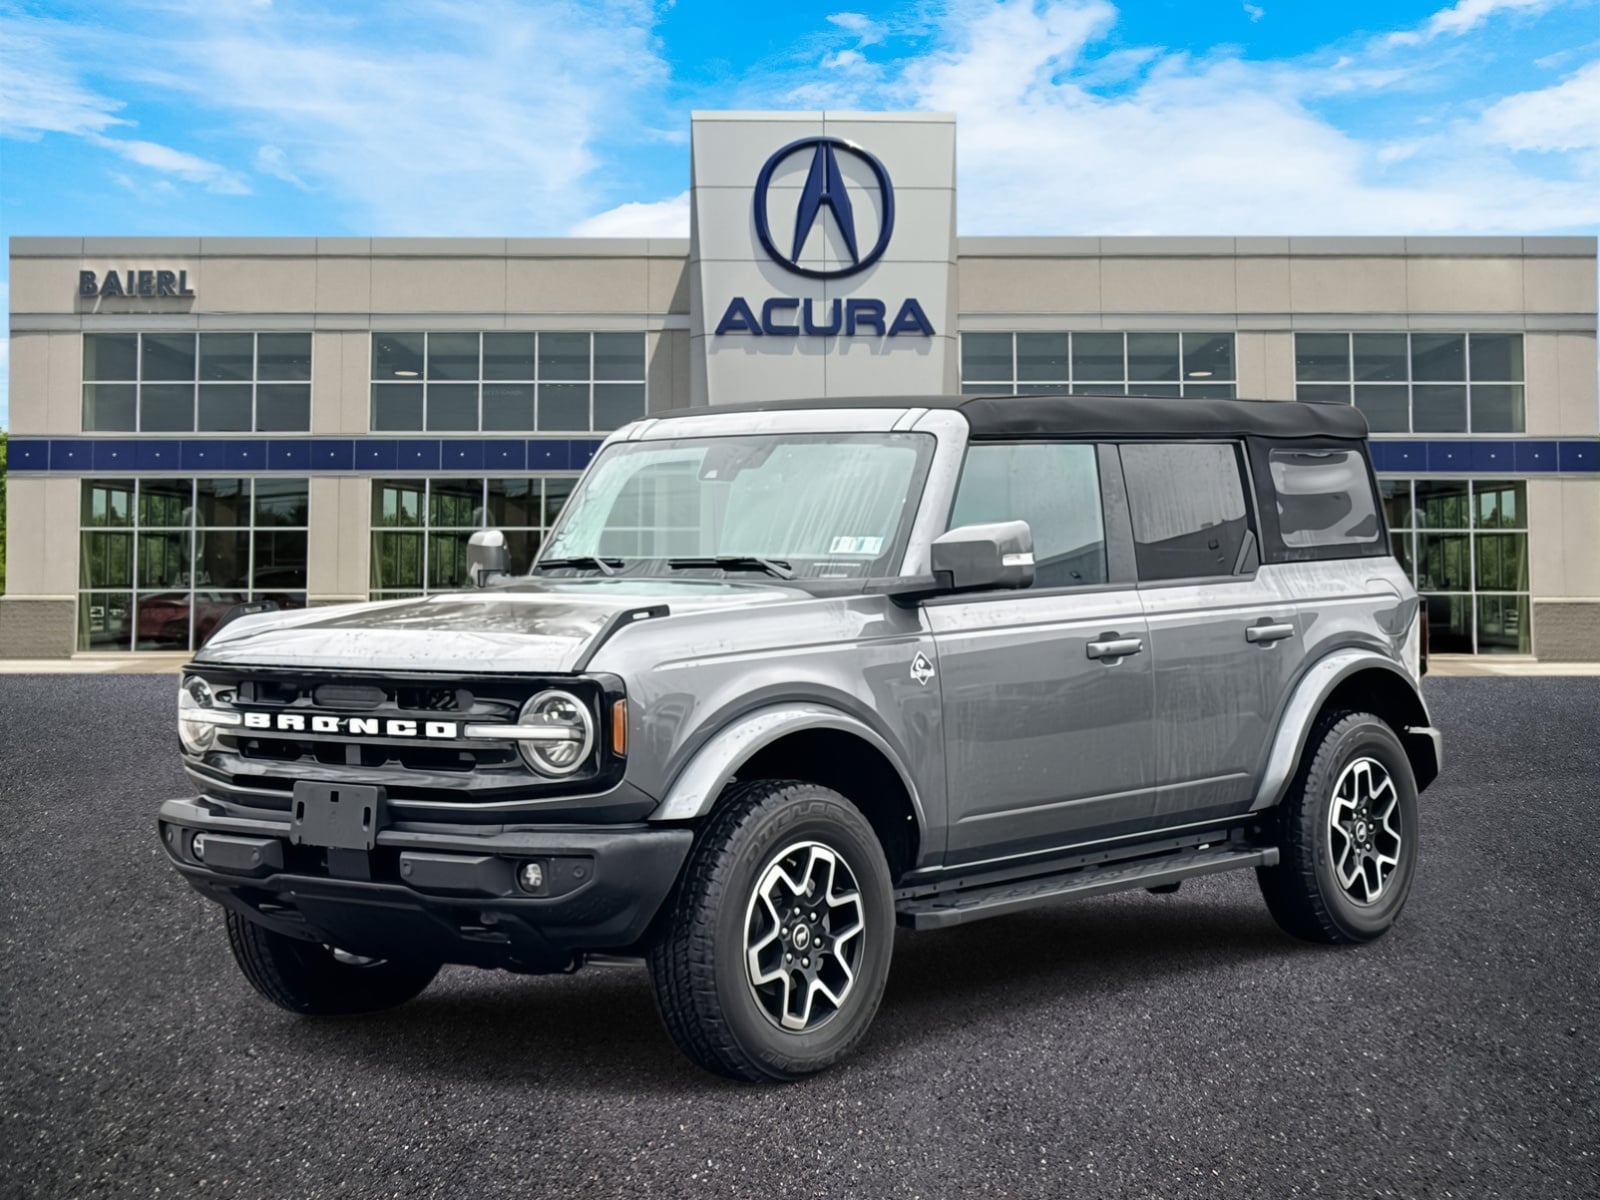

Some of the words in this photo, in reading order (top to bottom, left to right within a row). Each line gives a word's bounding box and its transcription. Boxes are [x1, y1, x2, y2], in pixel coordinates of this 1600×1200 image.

[79, 269, 194, 296] BAIERL
[715, 296, 936, 337] ACURA
[244, 712, 457, 738] BRONCO
